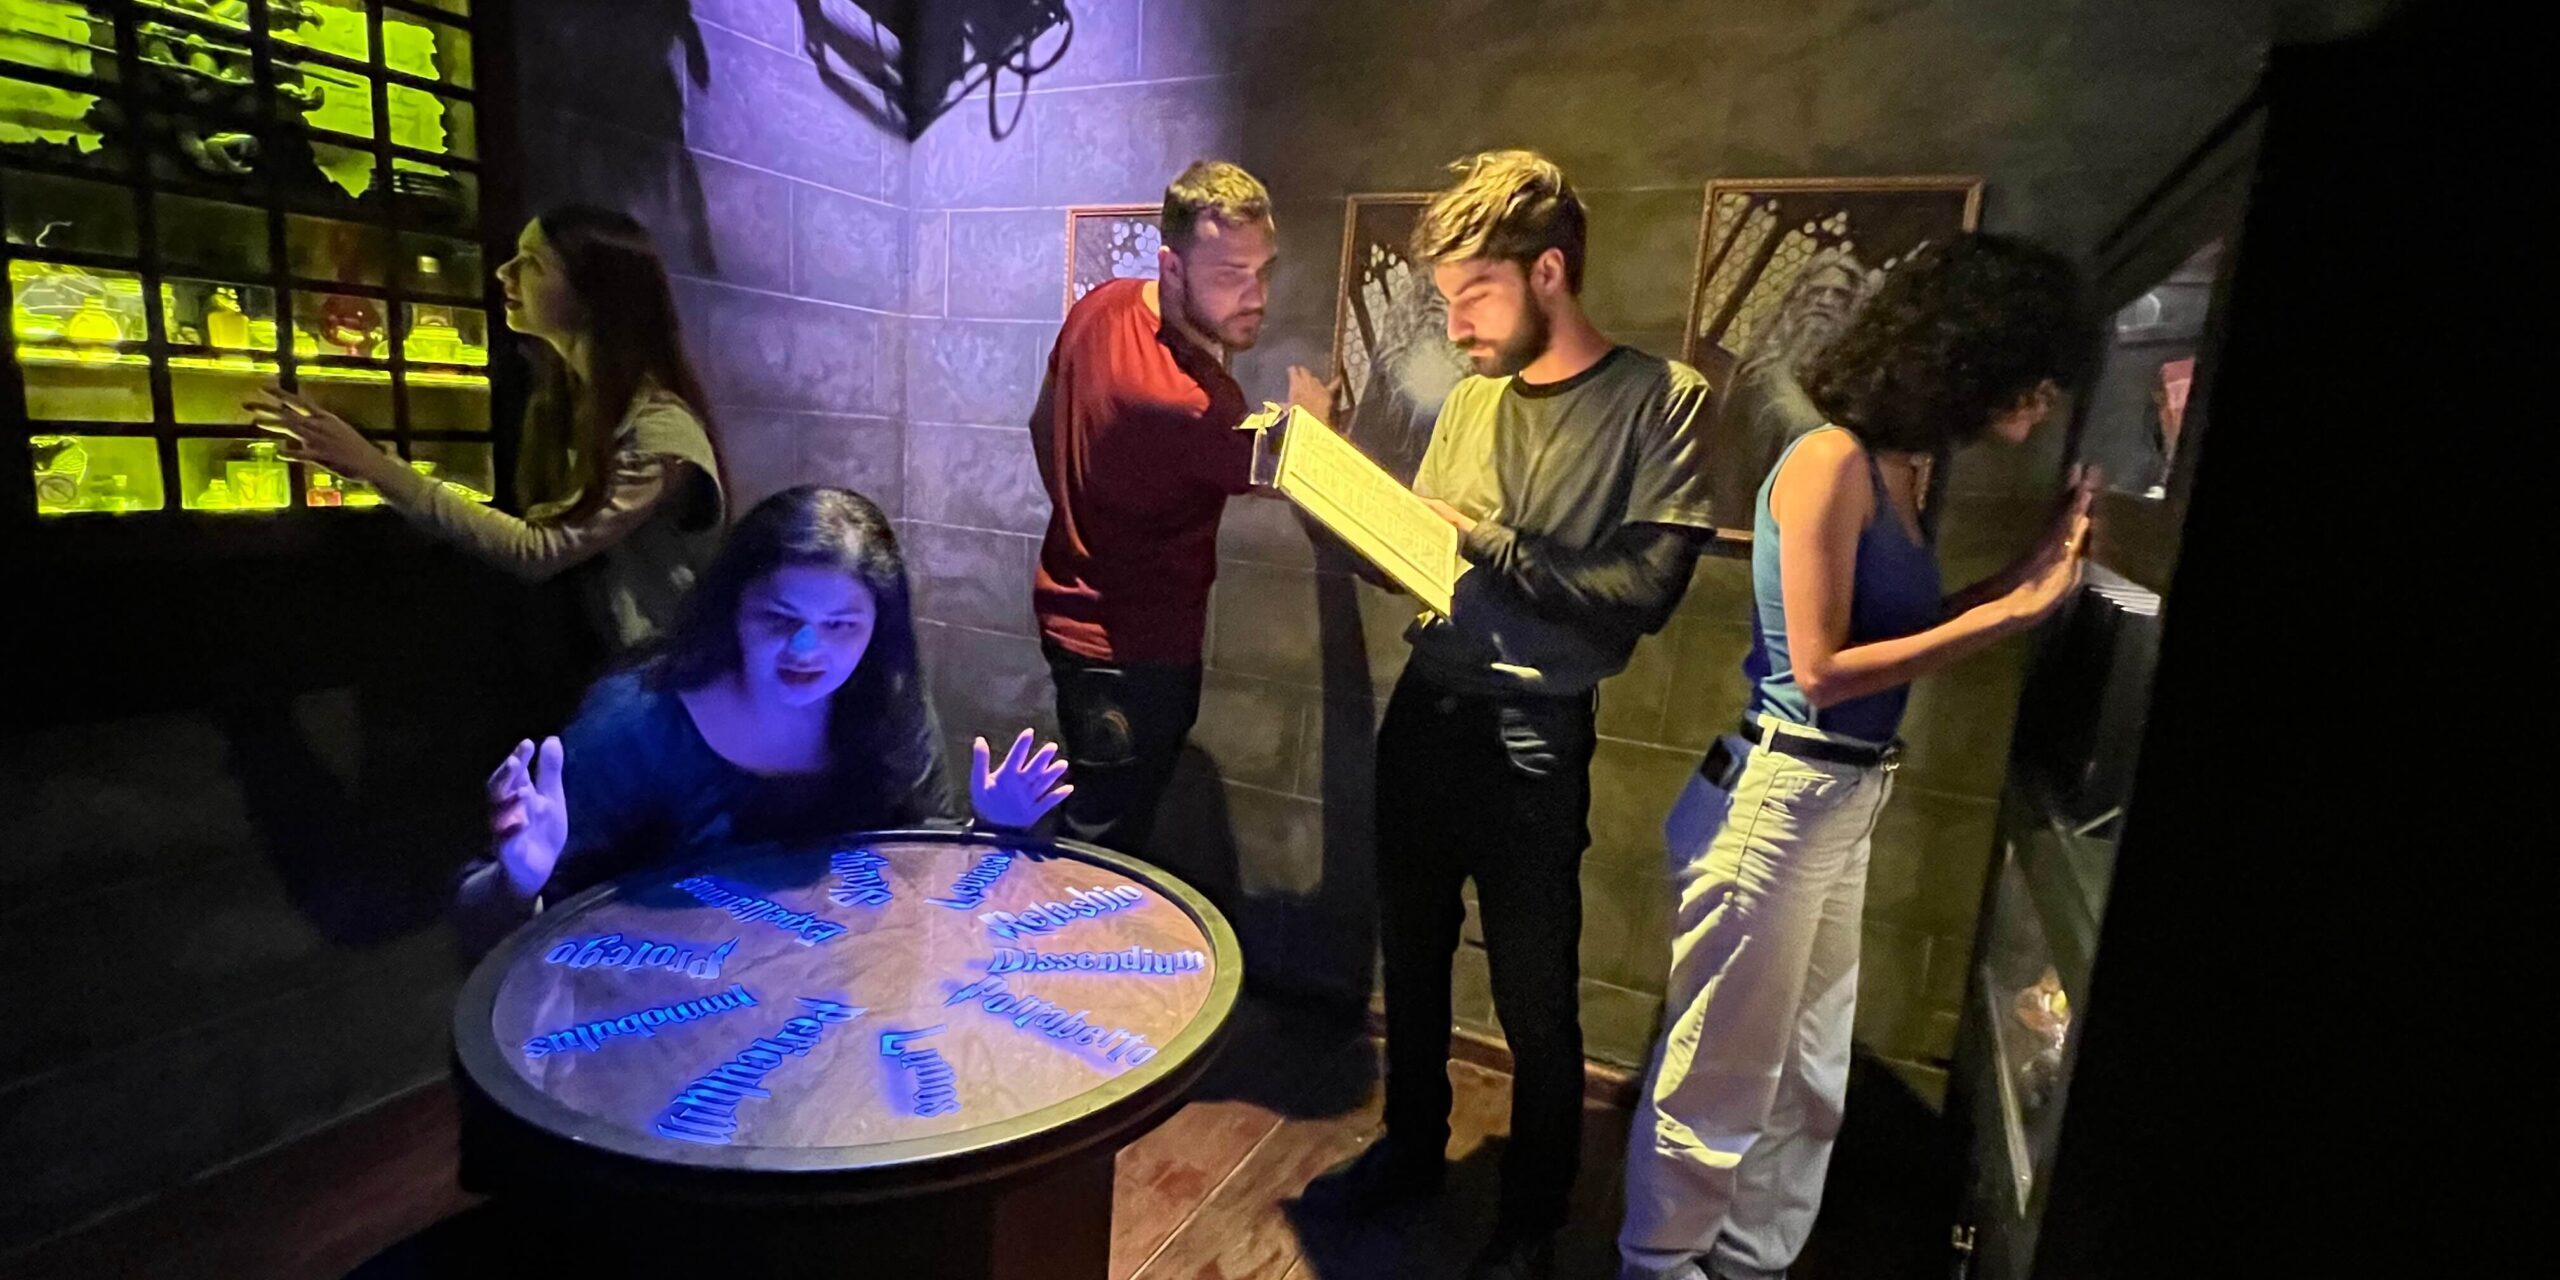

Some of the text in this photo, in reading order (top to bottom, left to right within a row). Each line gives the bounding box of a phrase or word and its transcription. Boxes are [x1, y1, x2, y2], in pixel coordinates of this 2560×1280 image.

[828, 850, 893, 907] Skurge
[923, 854, 1012, 910] Leviosa
[672, 876, 848, 948] Expelliarmus
[977, 884, 1143, 941] Relashio
[545, 933, 740, 979] Protego
[987, 944, 1206, 975] Dissendium
[521, 983, 759, 1059] Immobulus
[944, 974, 1158, 1067] Portaberto
[656, 997, 868, 1145] Periculum
[880, 1024, 961, 1118] Lumos
